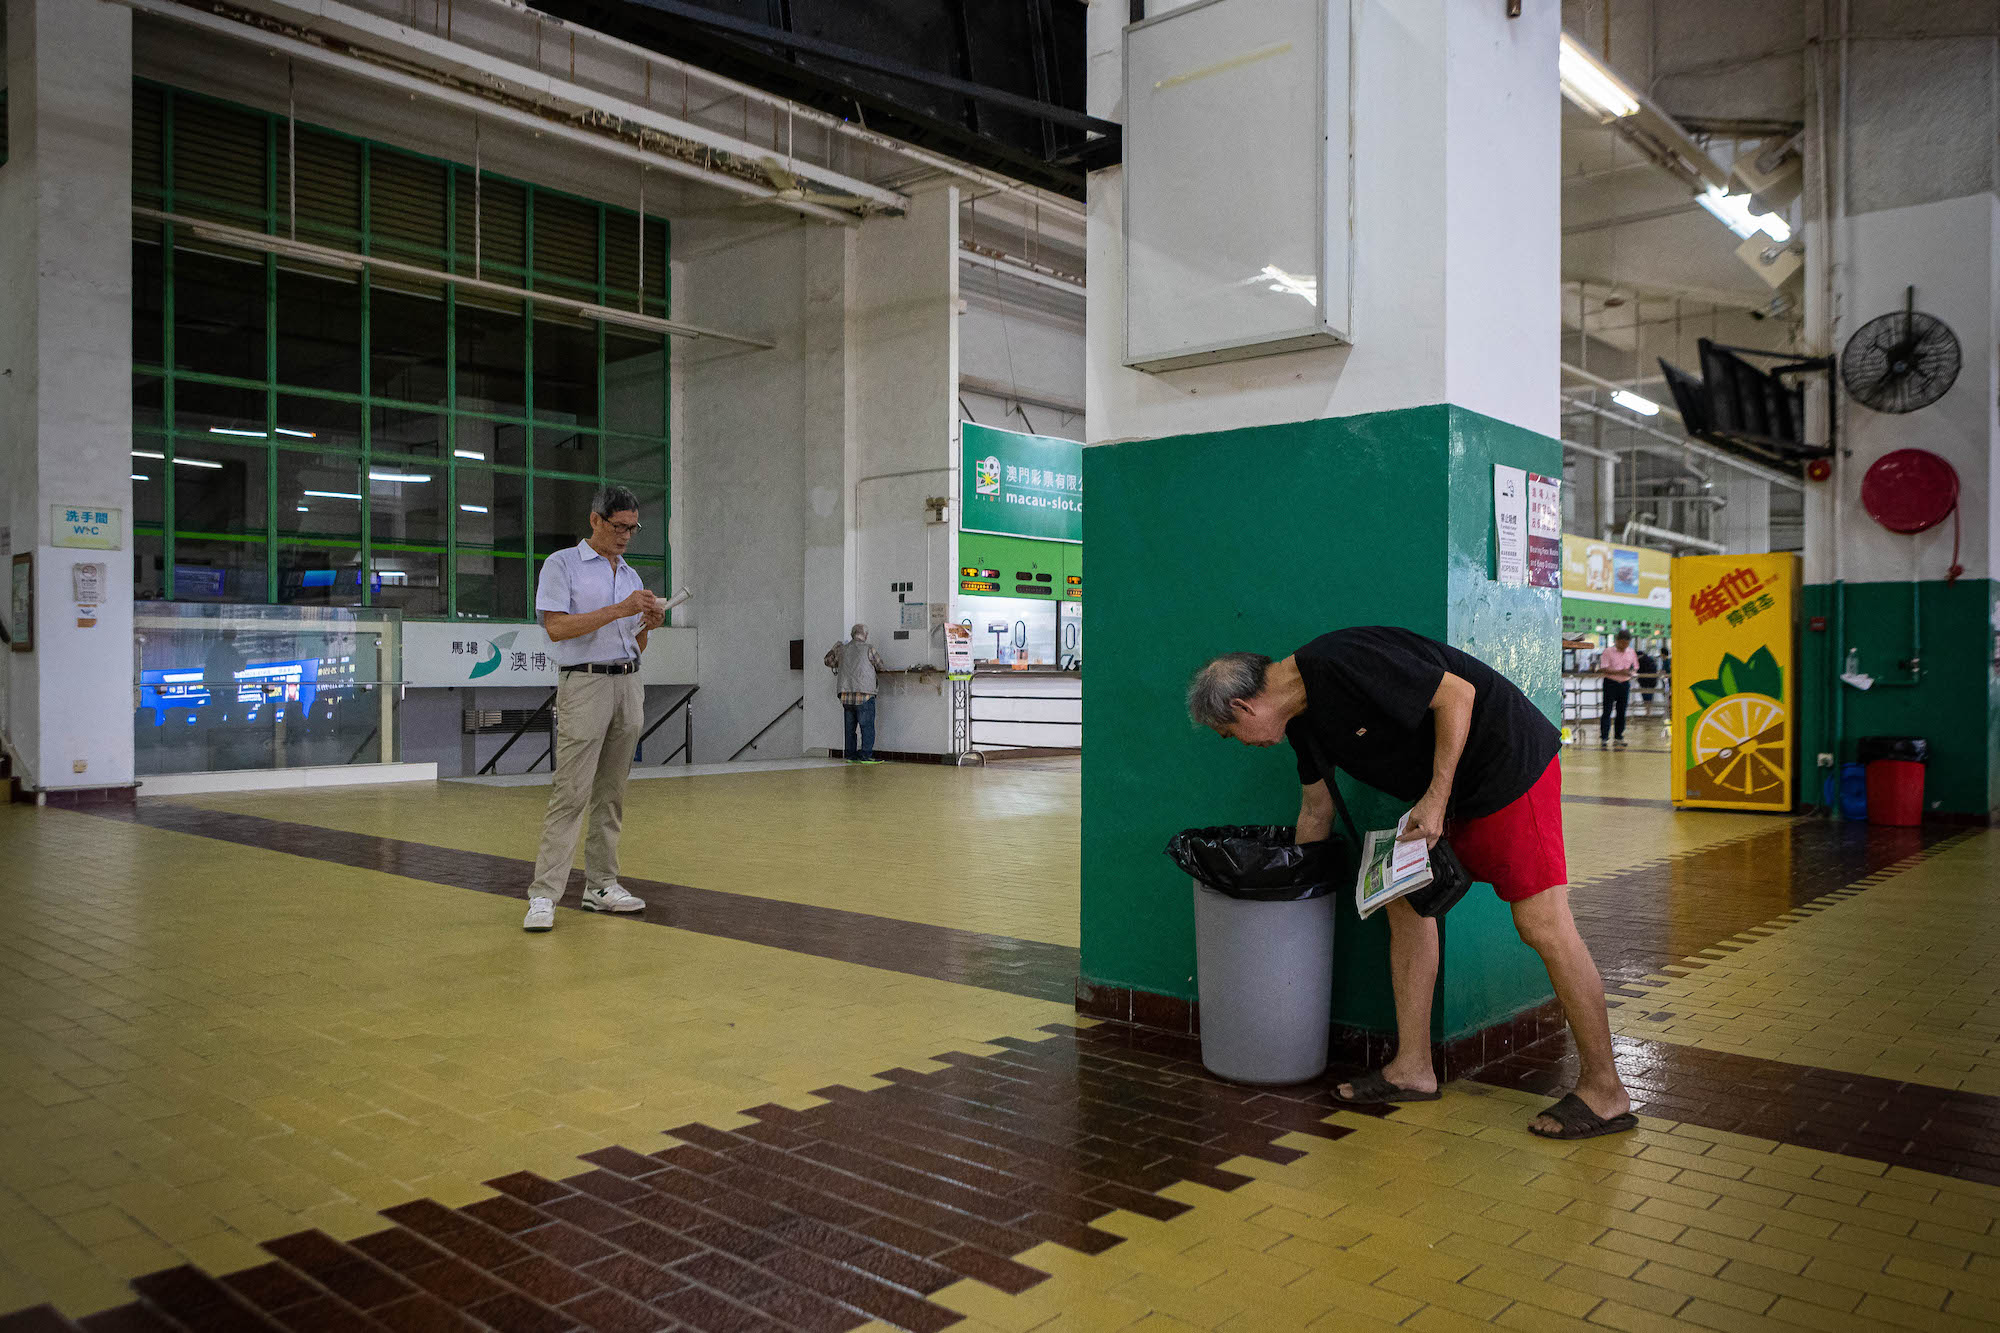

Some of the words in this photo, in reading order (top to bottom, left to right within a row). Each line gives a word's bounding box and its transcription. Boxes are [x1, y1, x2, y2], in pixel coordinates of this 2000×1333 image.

[66, 510, 108, 524] 洗手間
[452, 641, 478, 655] 馬場
[510, 651, 556, 673] 澳博
